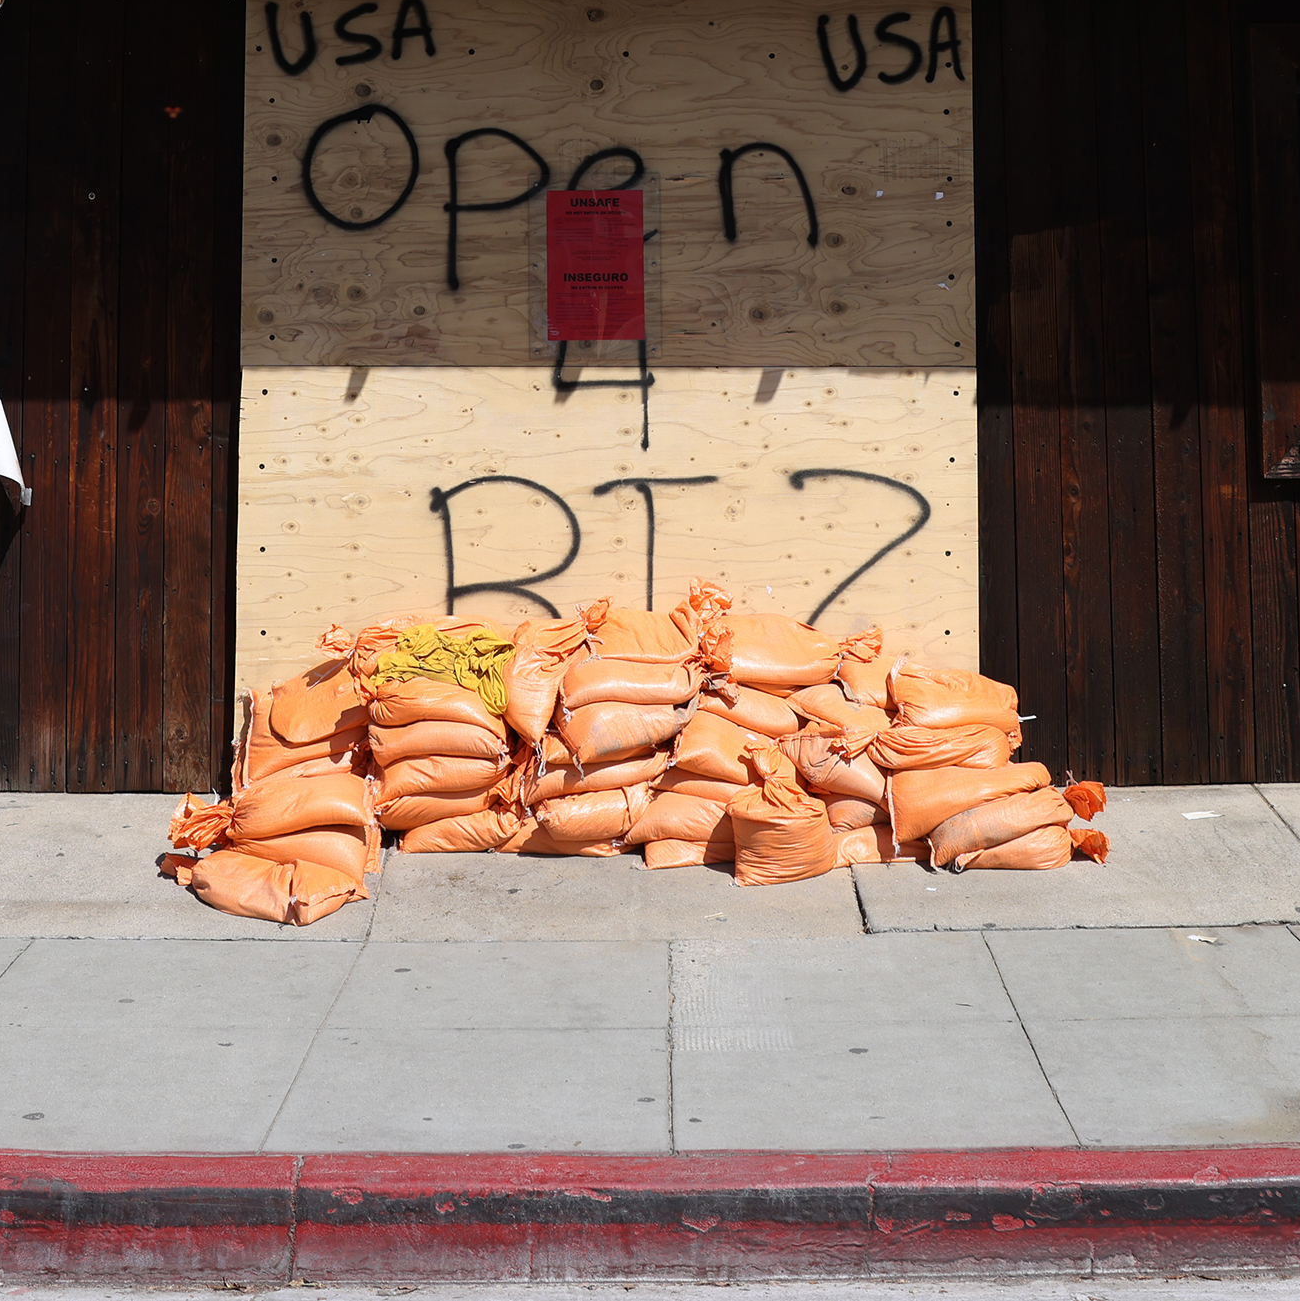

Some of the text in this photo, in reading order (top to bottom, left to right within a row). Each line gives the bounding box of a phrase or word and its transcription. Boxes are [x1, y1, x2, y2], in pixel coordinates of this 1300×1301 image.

[815, 6, 967, 92] USA
[569, 197, 621, 208] UNSAFE
[563, 272, 630, 282] INSEGURO
